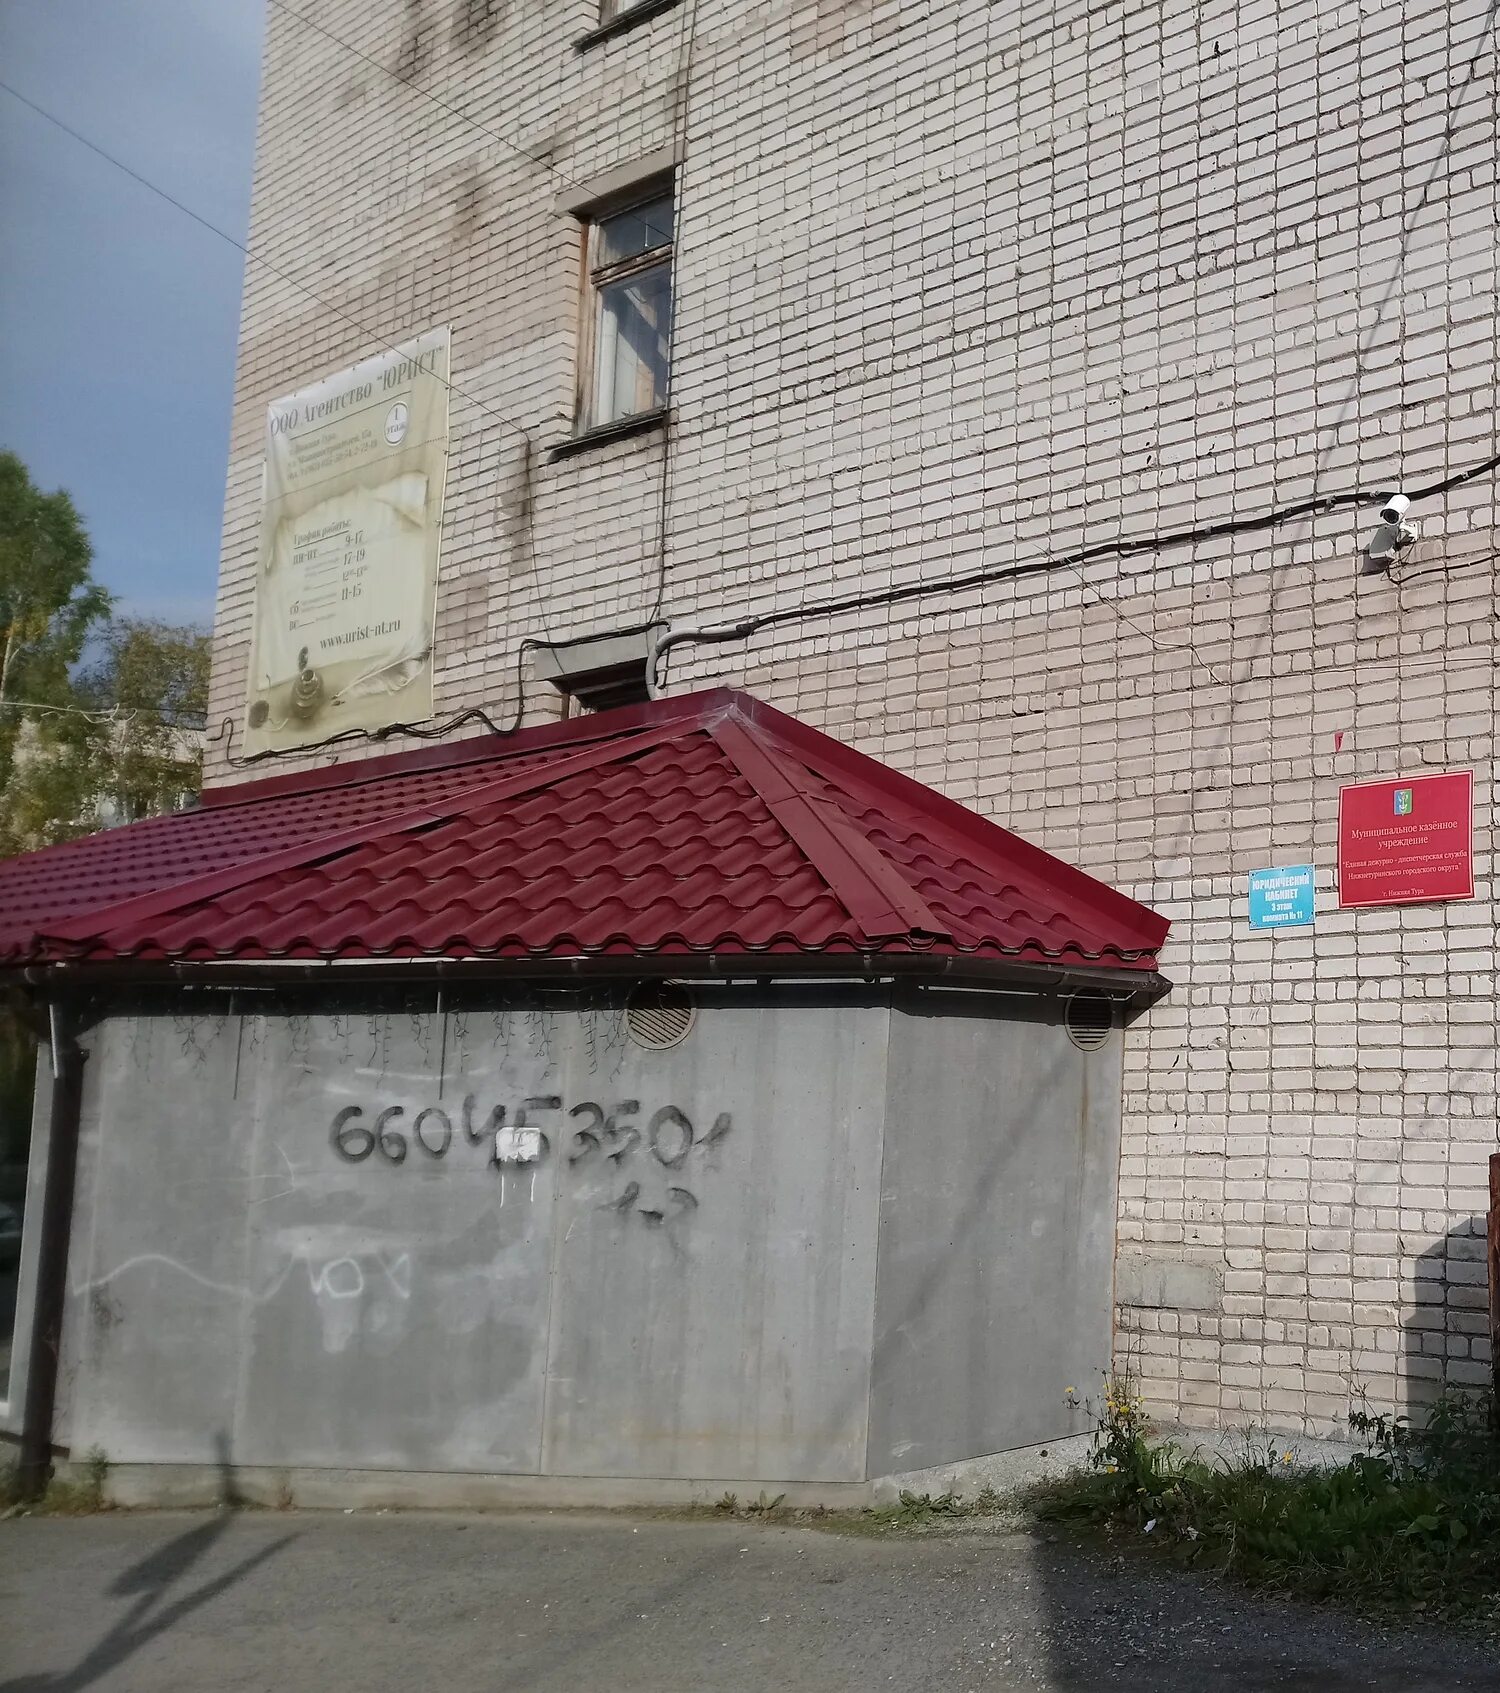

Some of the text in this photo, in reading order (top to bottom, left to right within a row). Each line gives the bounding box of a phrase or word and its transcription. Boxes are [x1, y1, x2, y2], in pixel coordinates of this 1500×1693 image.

[270, 407, 298, 437] ООО
[303, 382, 372, 423] Агентство
[345, 530, 364, 545] 9-17
[343, 549, 365, 566] 17-19
[341, 583, 362, 601] 11-15
[320, 619, 401, 649] www.urist-nt.ru
[1351, 819, 1458, 840] Муниципальное казённое
[1378, 835, 1429, 850] учреждение
[1252, 874, 1310, 891] ЮРИДИЧЕСКИЙ
[1264, 888, 1299, 902] КАБИНЕТ
[1271, 902, 1276, 911] 3
